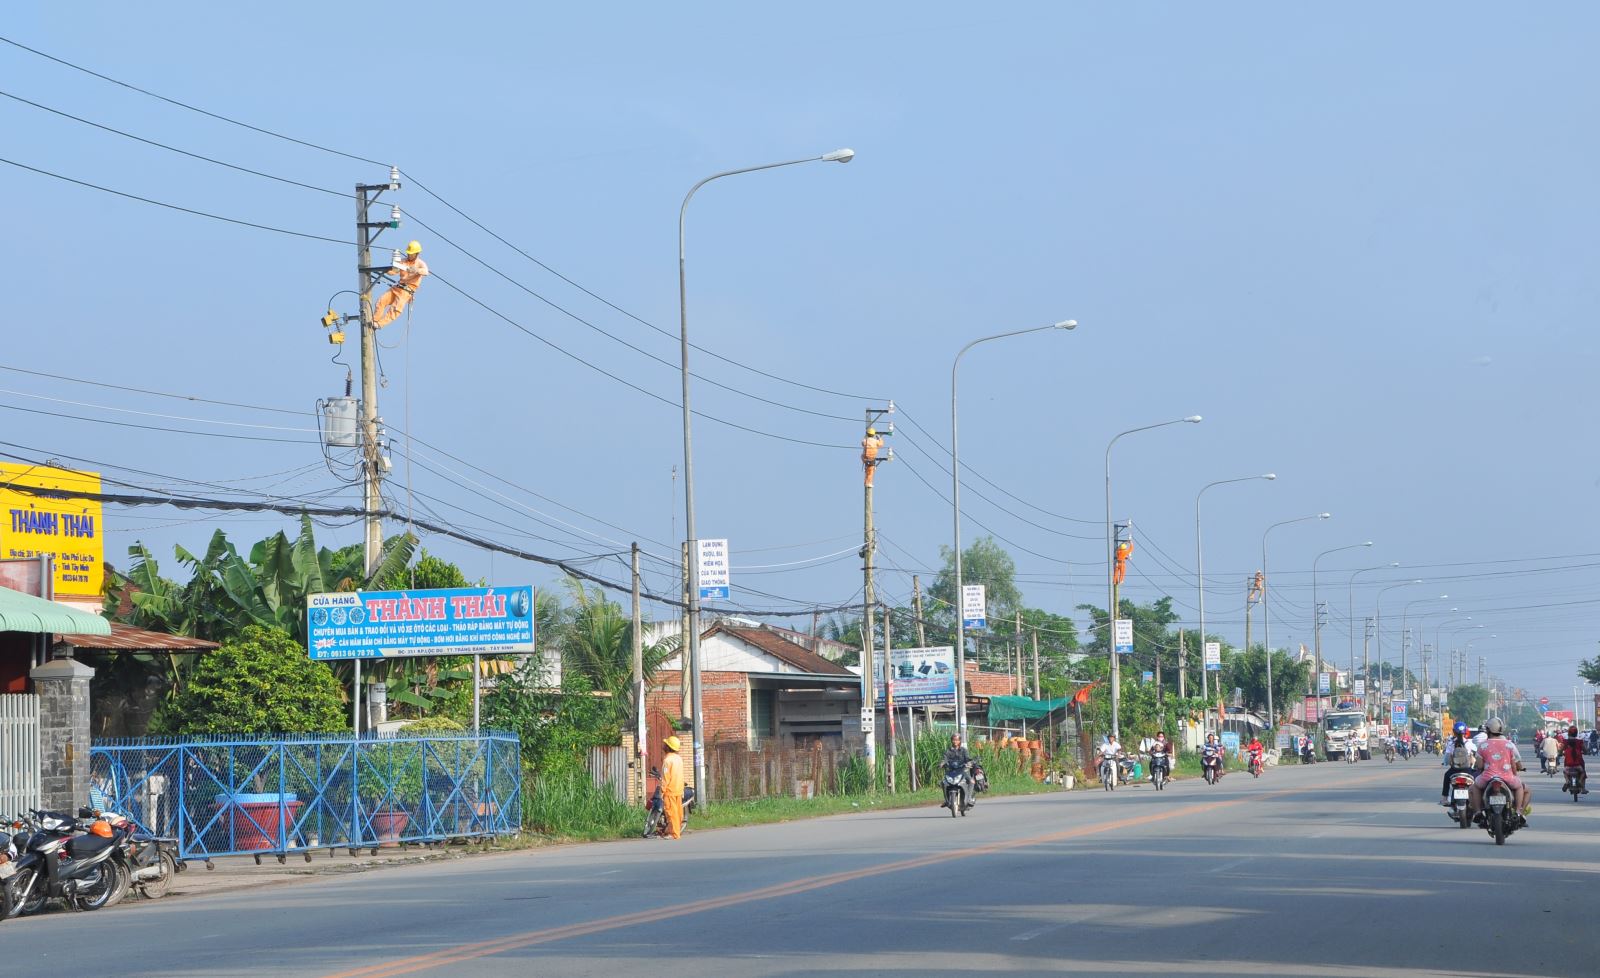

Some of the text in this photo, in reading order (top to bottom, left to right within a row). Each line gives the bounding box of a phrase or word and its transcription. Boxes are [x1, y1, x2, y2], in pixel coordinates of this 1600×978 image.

[9, 503, 94, 538] THÀNH THÁI
[366, 589, 506, 623] THÀNH THÁI
[365, 626, 379, 635] TRAO
[406, 625, 413, 633] XE
